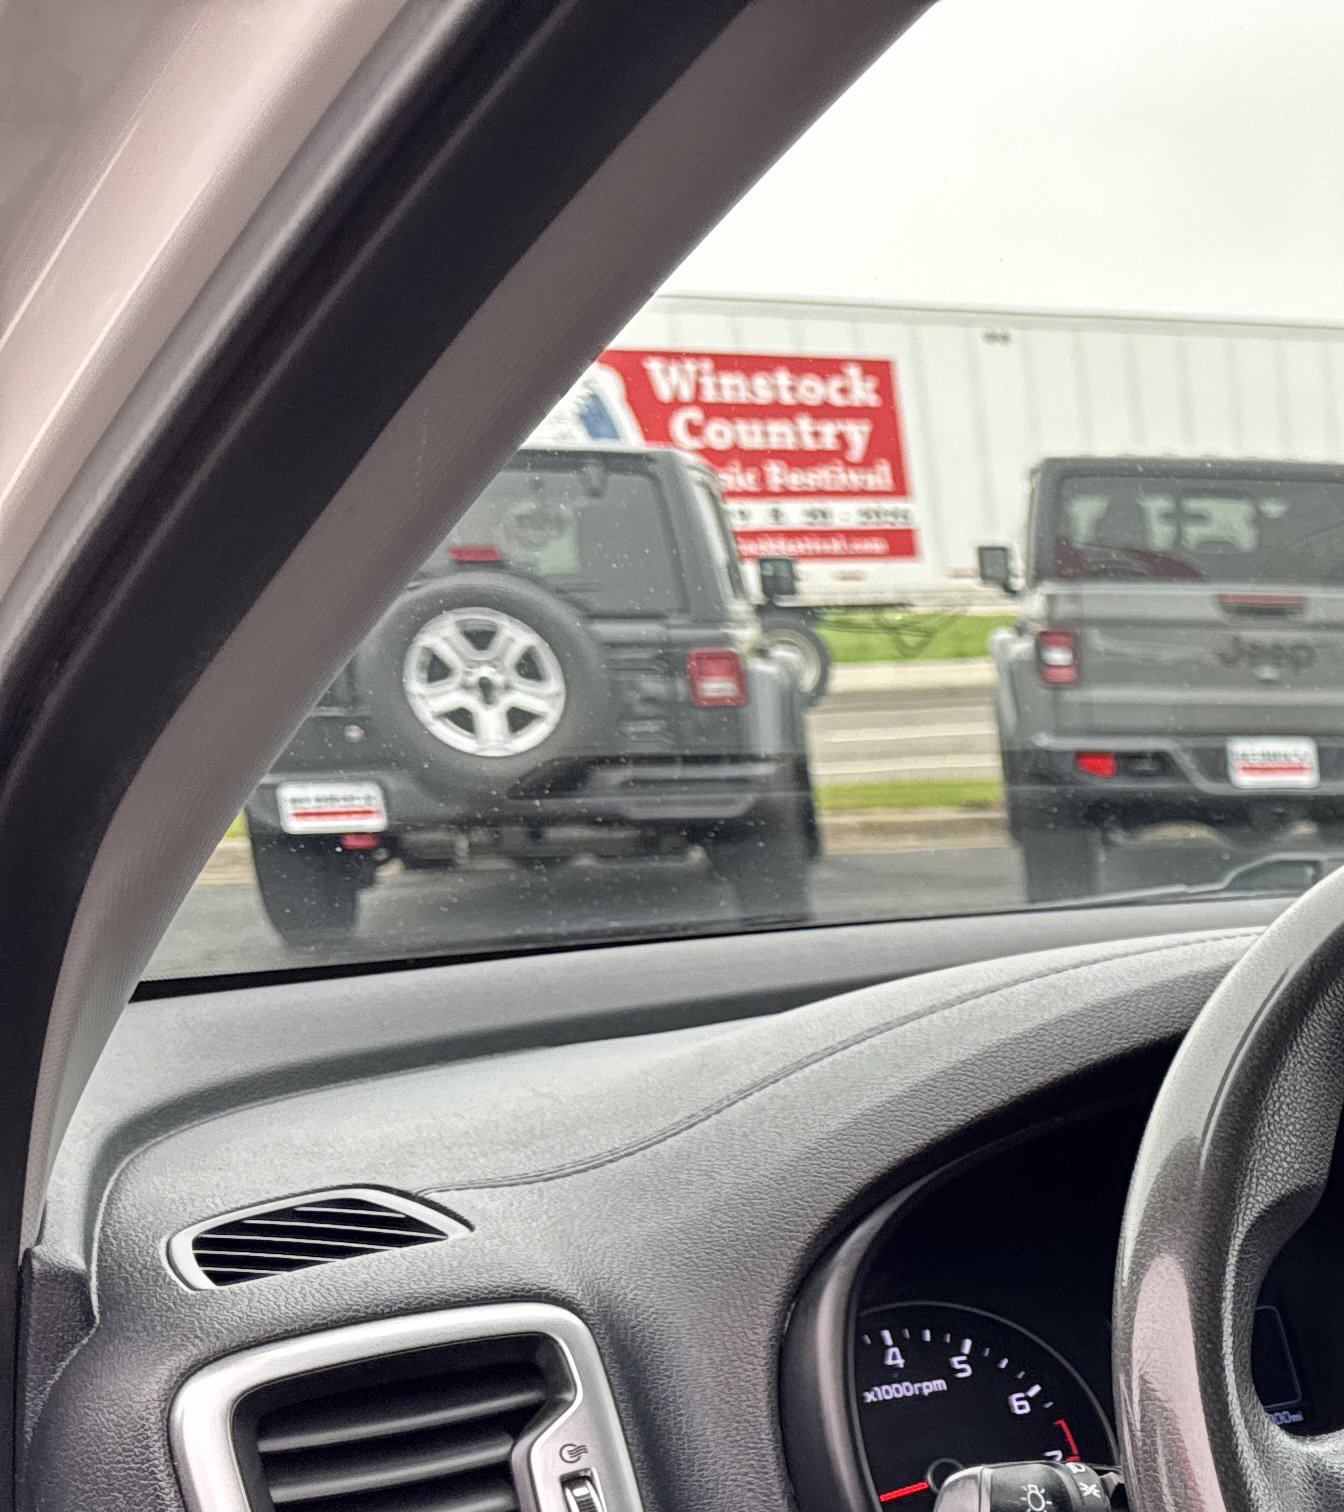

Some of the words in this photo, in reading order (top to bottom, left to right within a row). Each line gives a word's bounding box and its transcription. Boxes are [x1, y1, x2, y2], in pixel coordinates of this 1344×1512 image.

[642, 356, 882, 407] Winstock
[668, 406, 872, 462] Country
[762, 460, 895, 492] Festival
[884, 1348, 905, 1368] 4
[951, 1355, 972, 1378] 5
[864, 1379, 947, 1403] x1000rpm
[1009, 1393, 1031, 1415] 6
